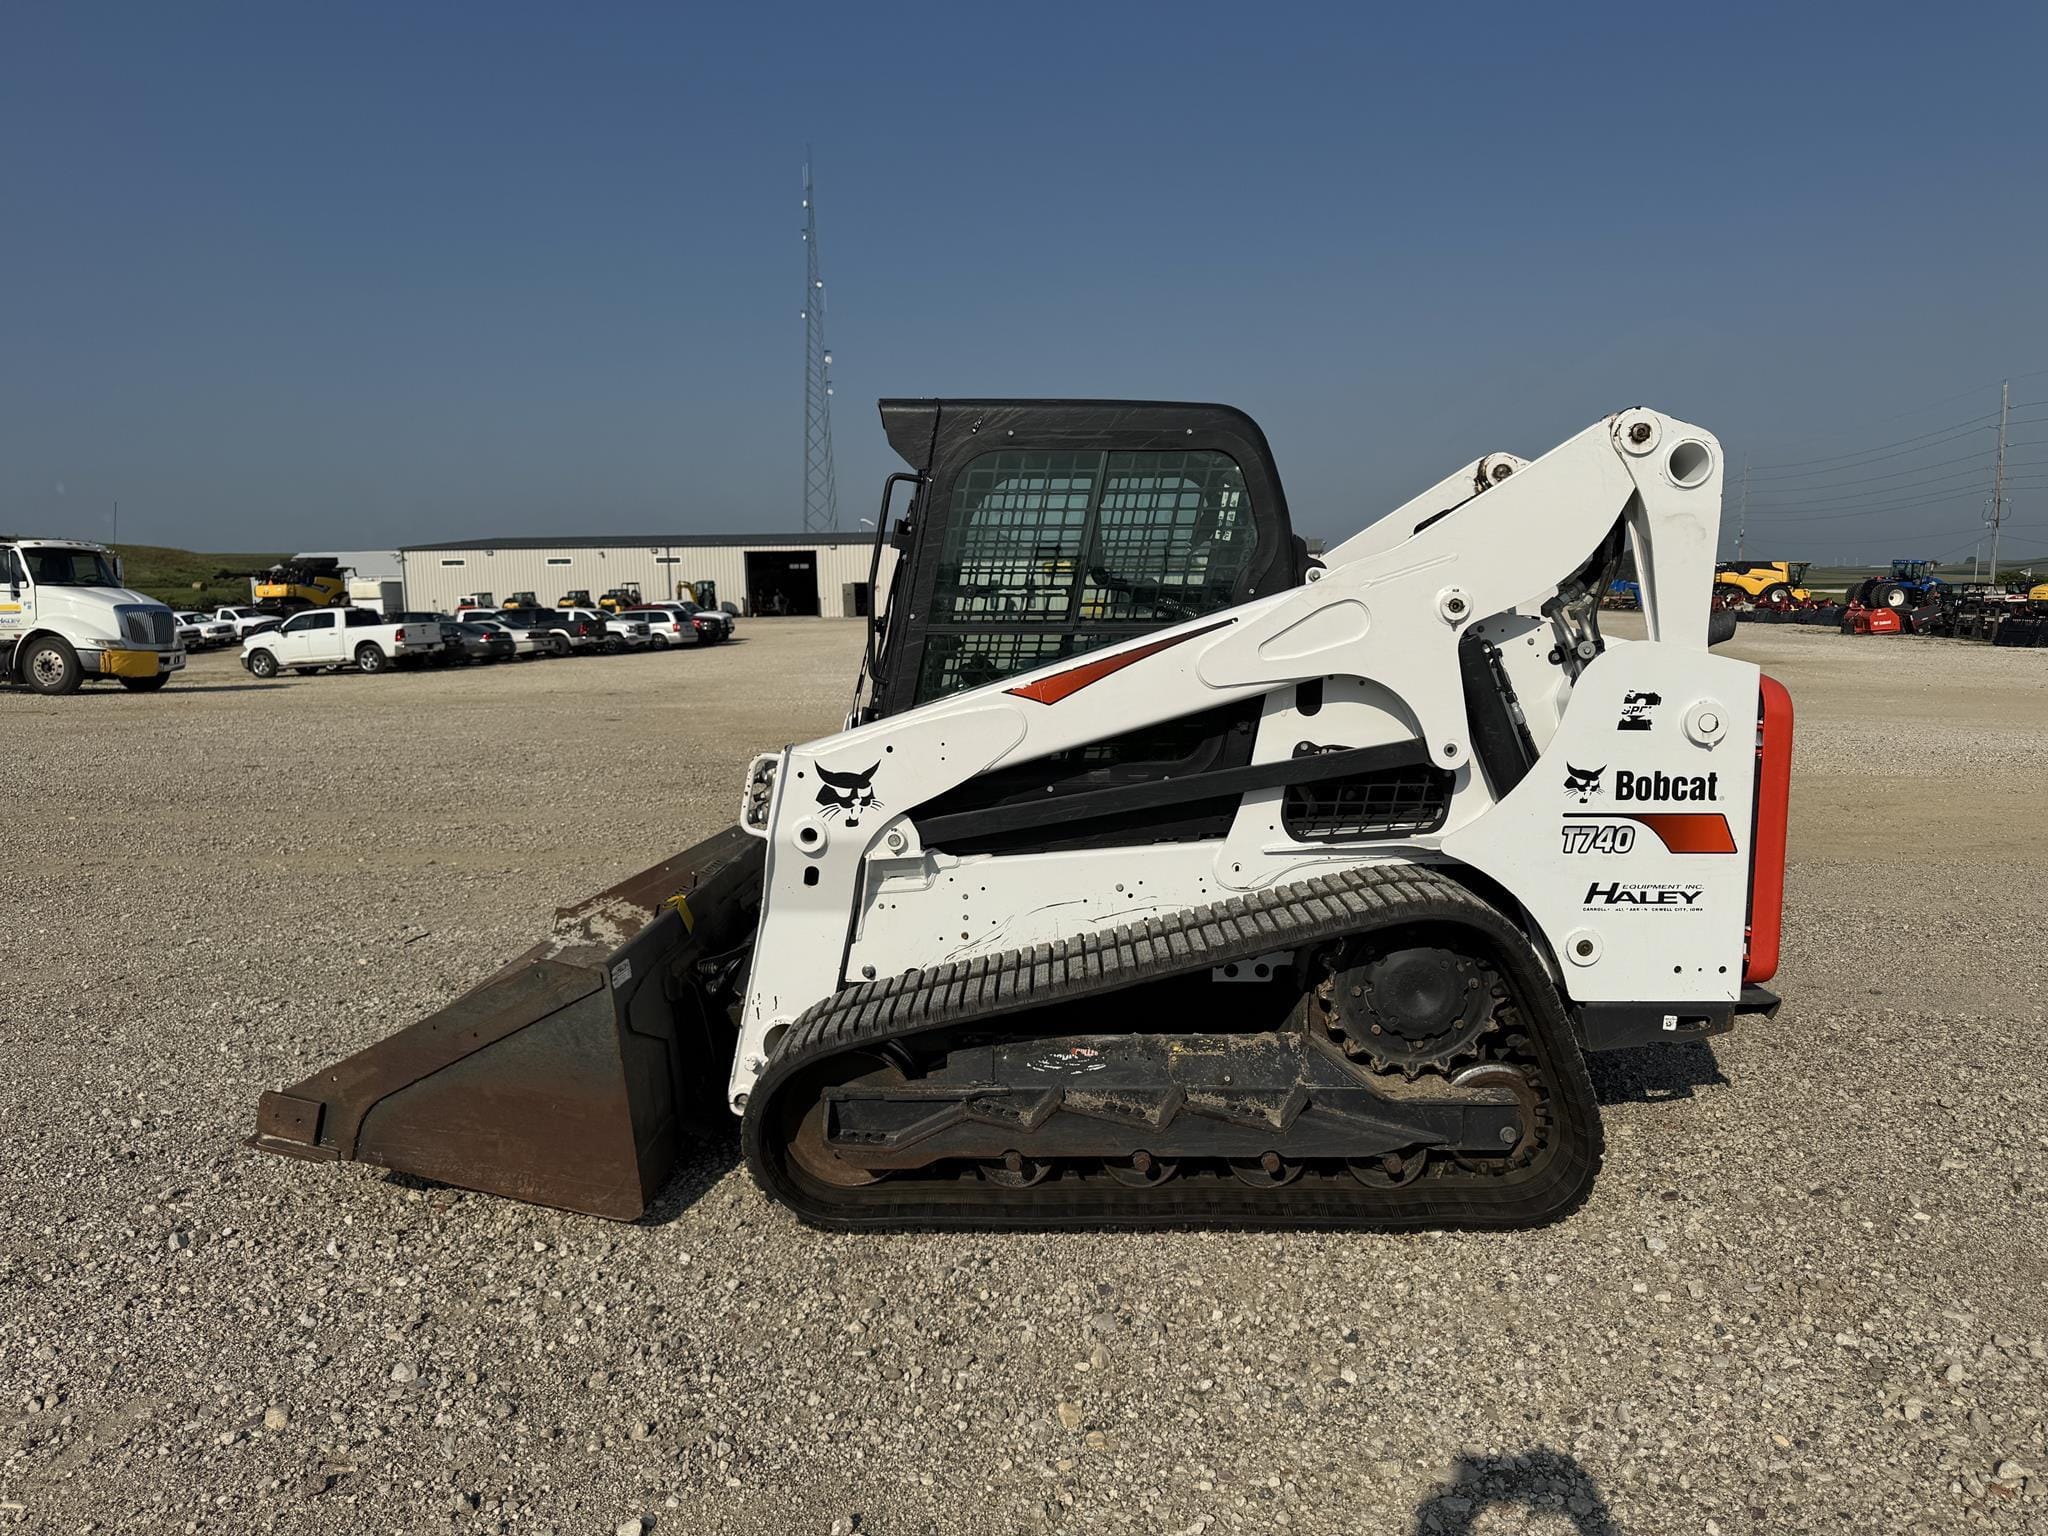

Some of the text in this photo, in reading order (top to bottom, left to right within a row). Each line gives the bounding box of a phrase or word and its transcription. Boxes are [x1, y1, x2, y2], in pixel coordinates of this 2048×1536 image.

[1615, 770, 1718, 801] Bobcat
[1562, 825, 1636, 854] T740
[1583, 882, 1704, 905] HALEY
